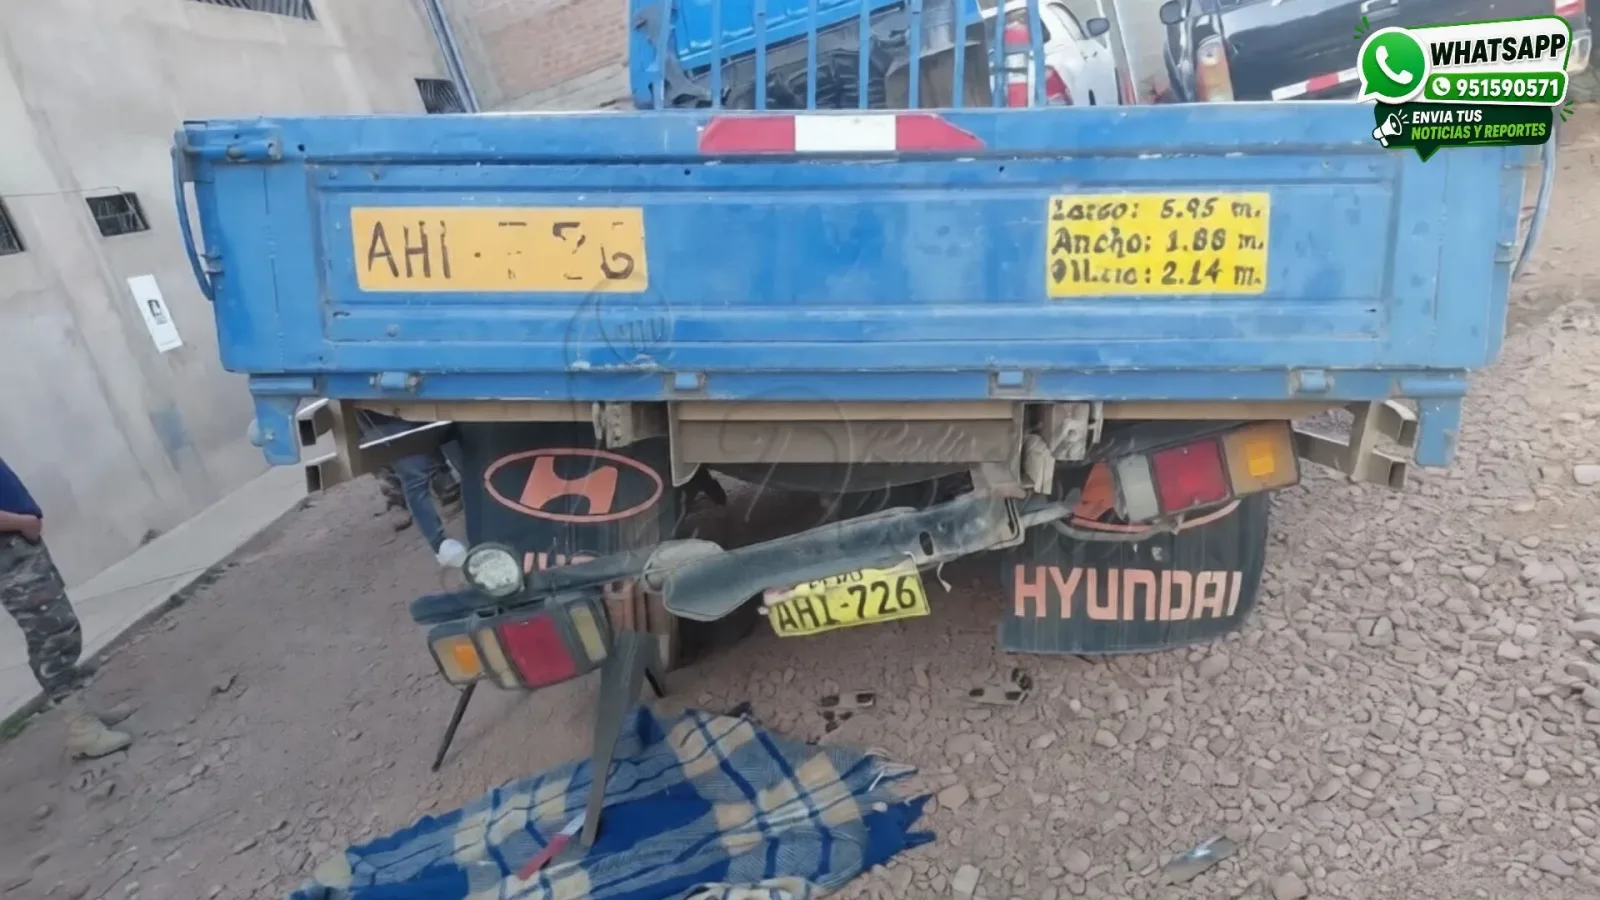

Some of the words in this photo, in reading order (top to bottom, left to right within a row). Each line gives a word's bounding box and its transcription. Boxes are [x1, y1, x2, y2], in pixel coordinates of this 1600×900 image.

[1160, 197, 1220, 219] 5.95
[1051, 226, 1151, 258] Ancho:
[1161, 257, 1223, 285] 2.14
[775, 574, 917, 631] AHI-726
[1013, 564, 1243, 621] HYUNDAI
